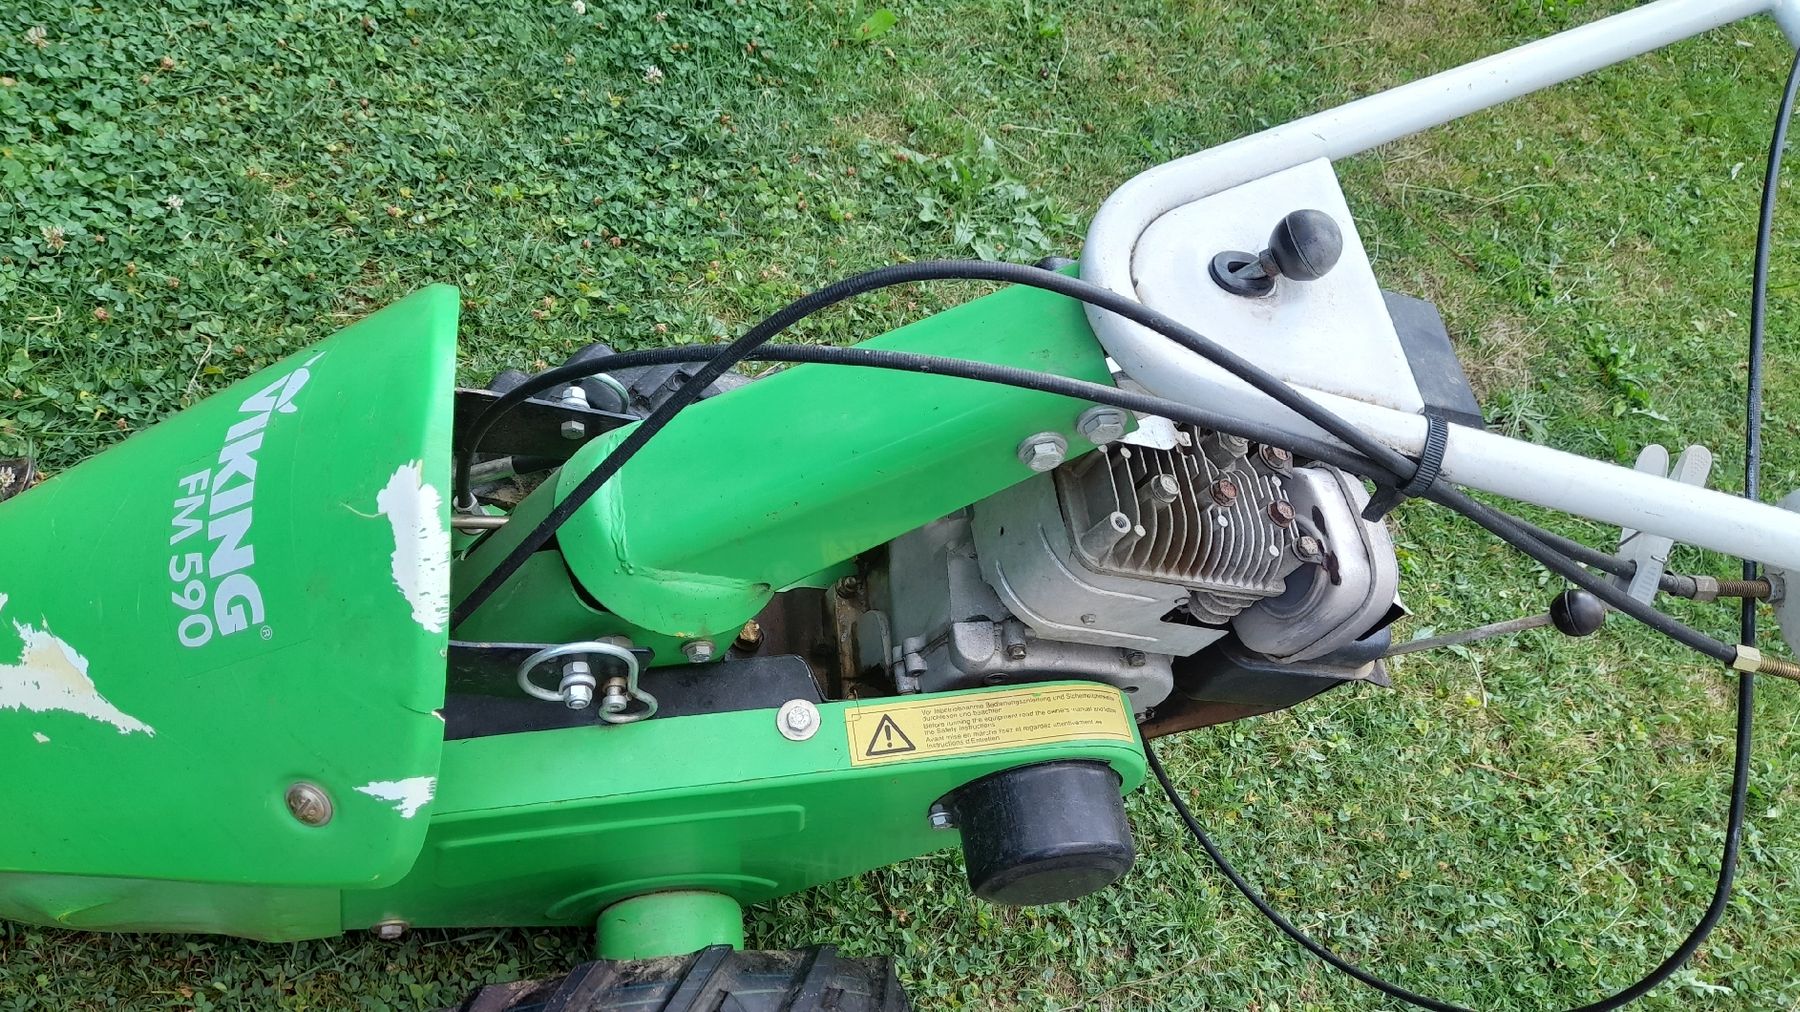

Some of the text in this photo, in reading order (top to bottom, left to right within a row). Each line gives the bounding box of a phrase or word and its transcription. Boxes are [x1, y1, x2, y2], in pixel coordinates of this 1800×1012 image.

[168, 468, 213, 648] FM 590
[208, 356, 314, 636] VIKING
